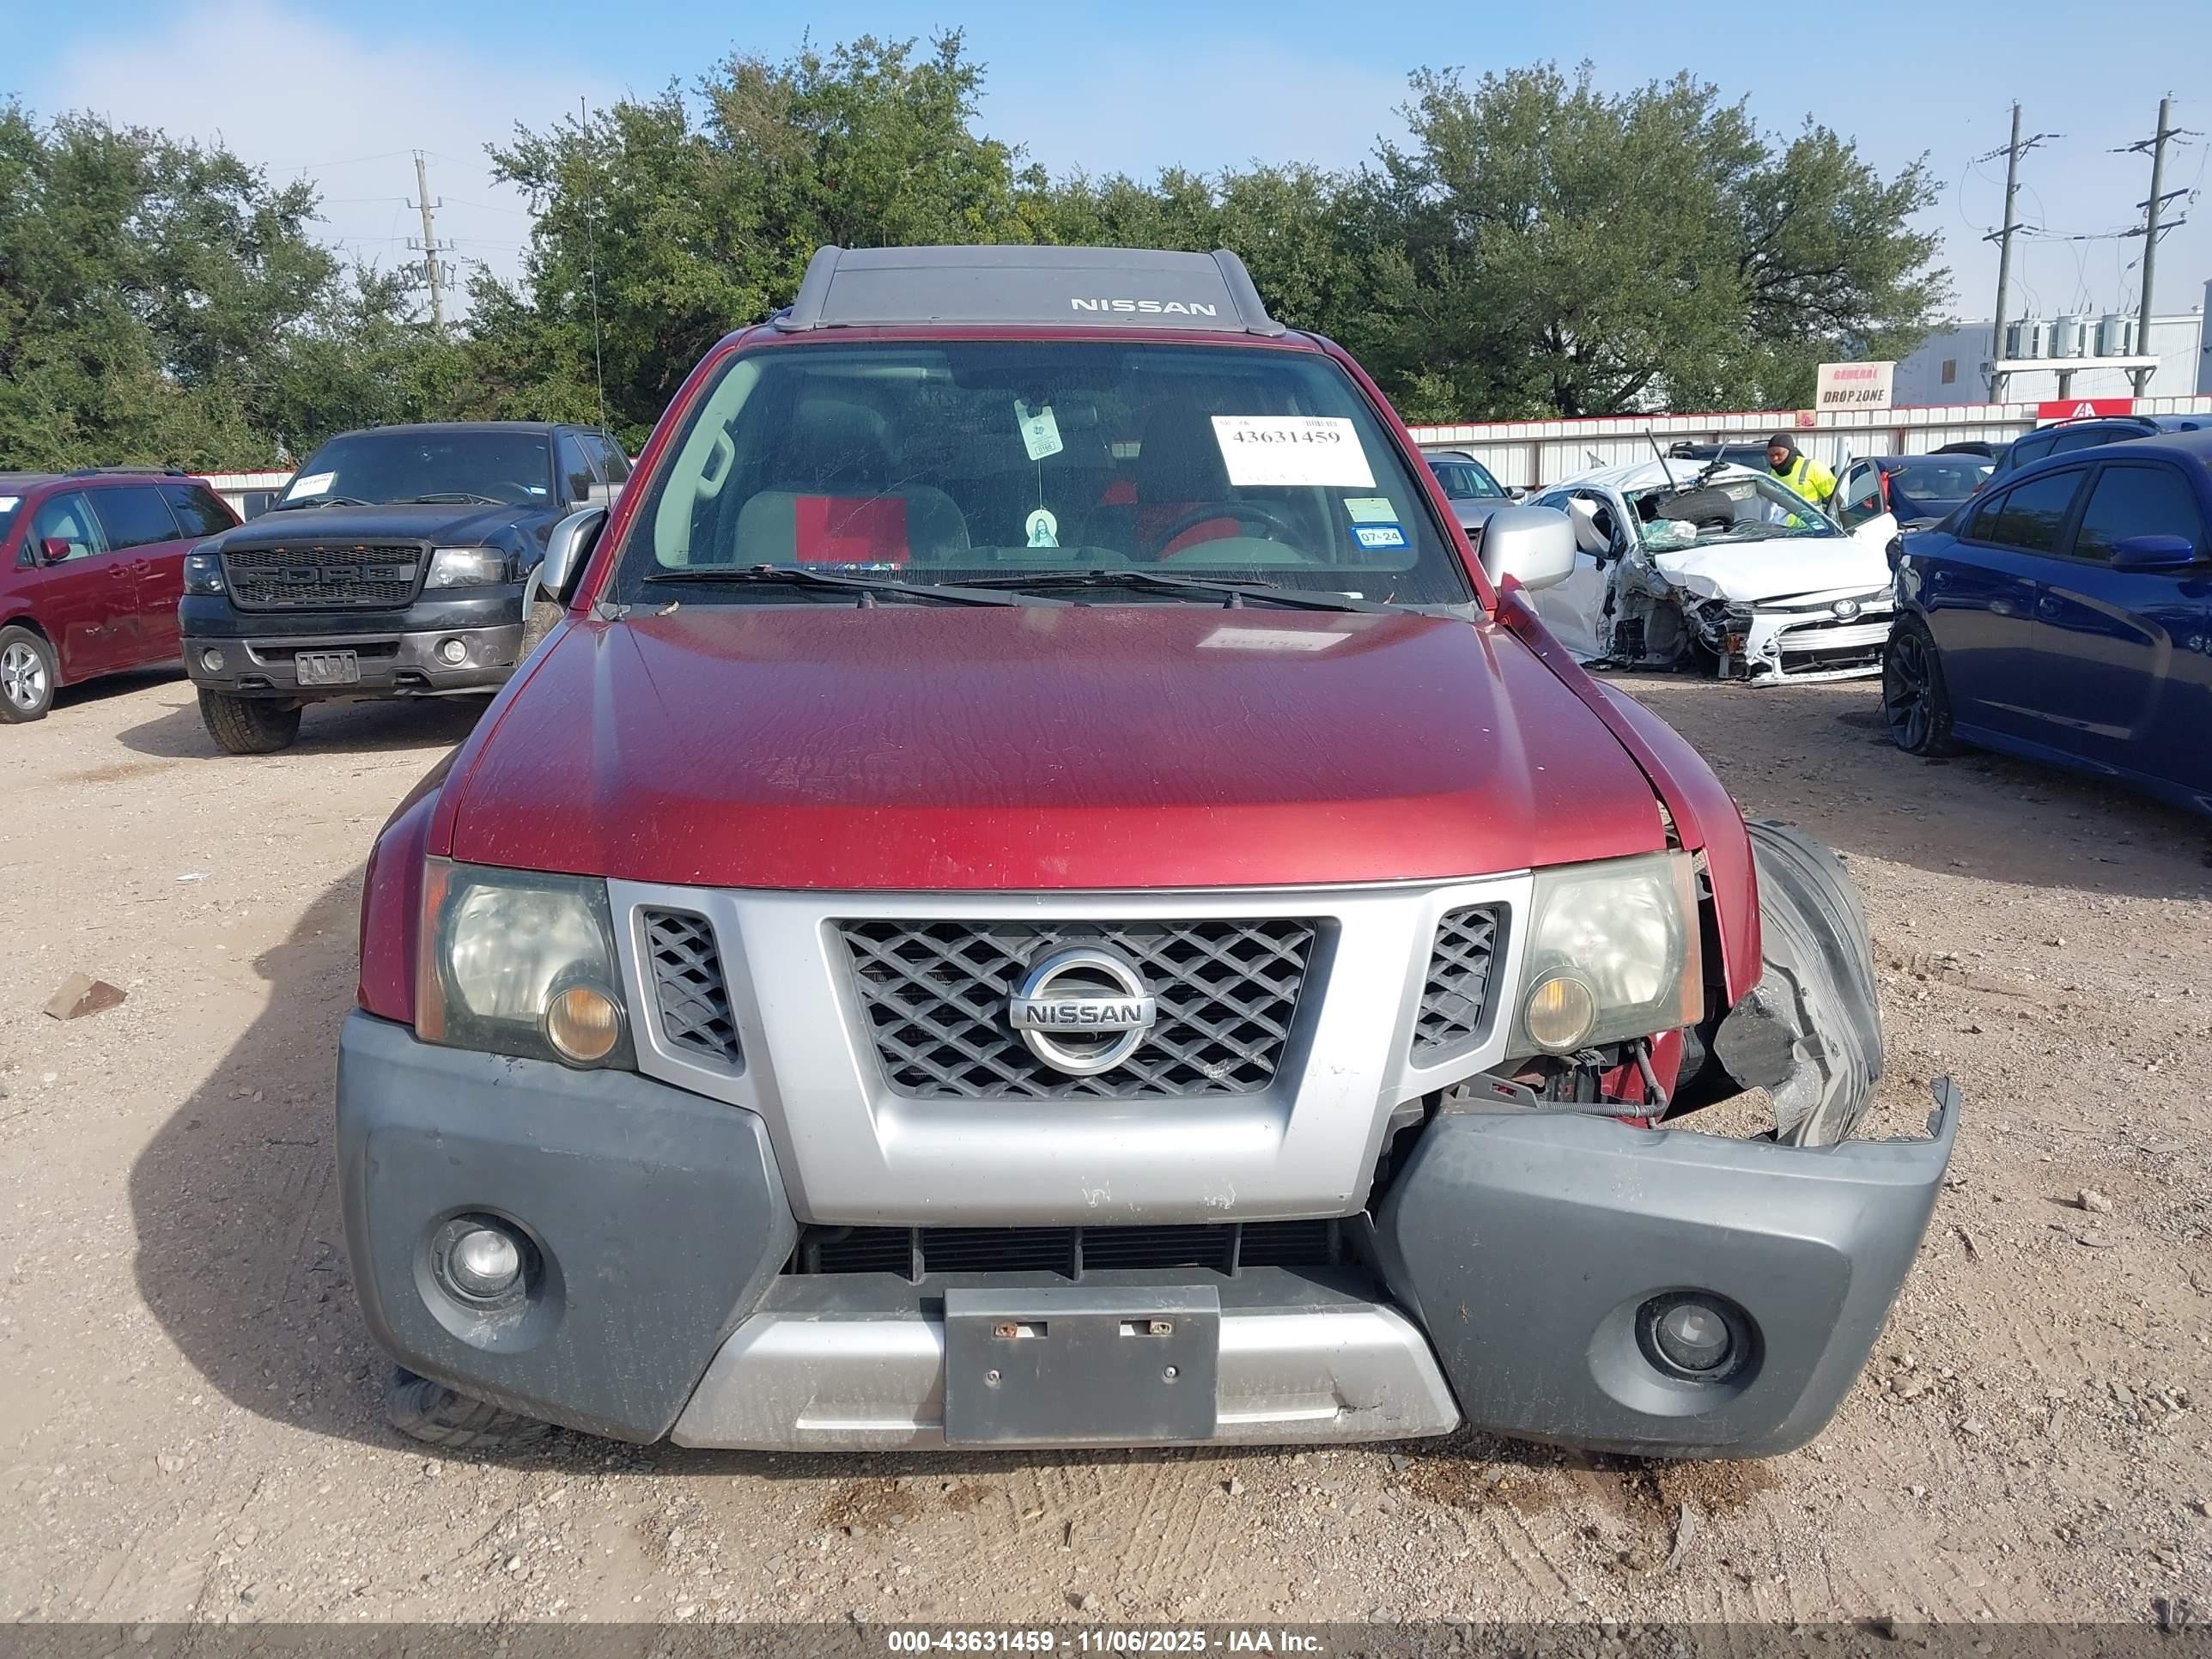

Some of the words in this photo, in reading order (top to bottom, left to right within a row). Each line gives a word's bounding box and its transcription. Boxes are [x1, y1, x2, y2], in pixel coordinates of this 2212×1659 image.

[1071, 298, 1218, 317] NISSAN
[1833, 368, 1879, 380] GENERAL
[1823, 390, 1856, 404] DROP
[1856, 389, 1885, 403] ZONE
[1232, 430, 1340, 444] 43631459
[1026, 1006, 1141, 1024] NISSAN
